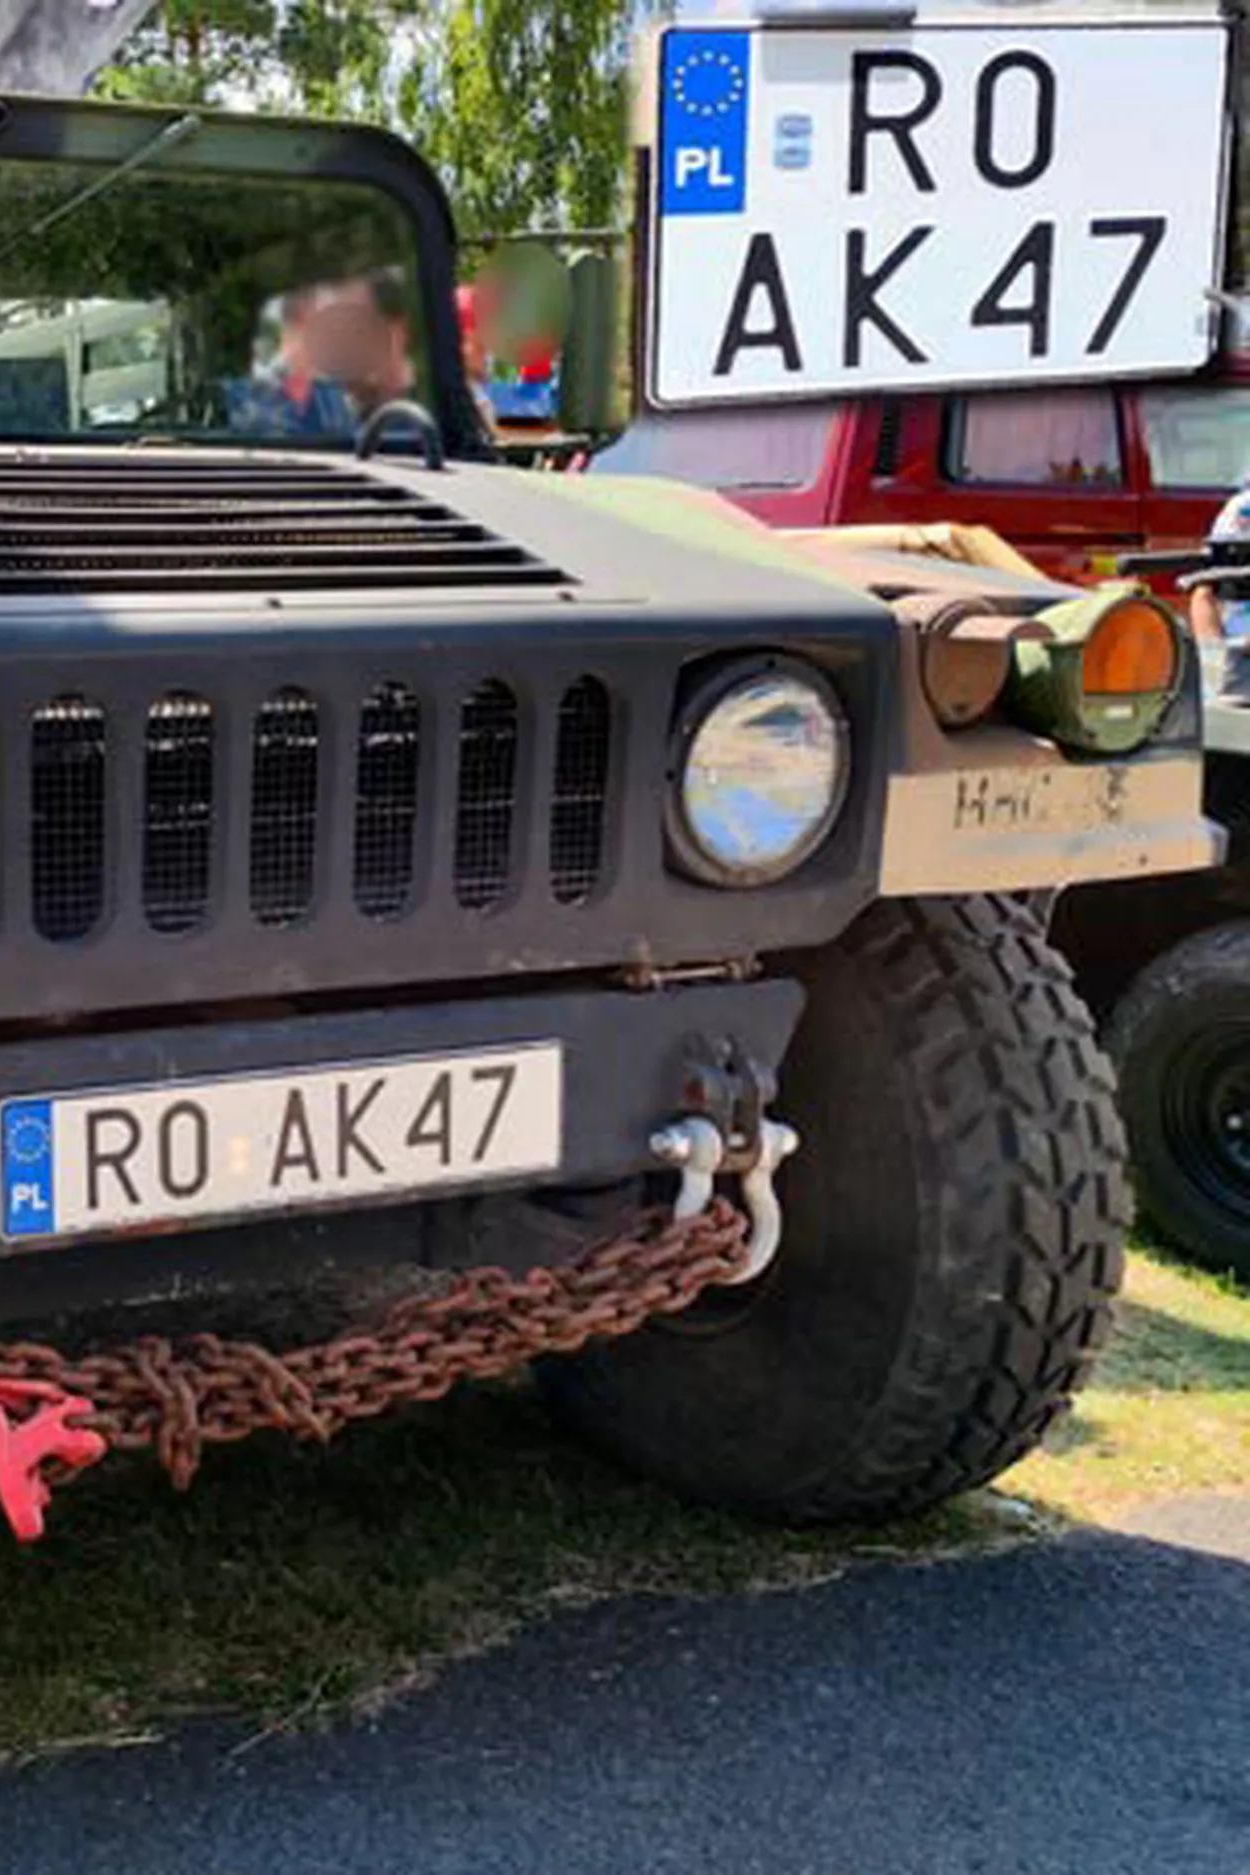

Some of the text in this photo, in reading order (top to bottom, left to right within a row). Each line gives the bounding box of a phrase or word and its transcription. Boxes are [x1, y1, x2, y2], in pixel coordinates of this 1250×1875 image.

[675, 146, 734, 189] PL
[847, 49, 1056, 194] RO
[712, 217, 1168, 376] AK47
[85, 1099, 208, 1210] RO
[270, 1065, 518, 1188] AK47
[10, 1183, 48, 1213] PL
